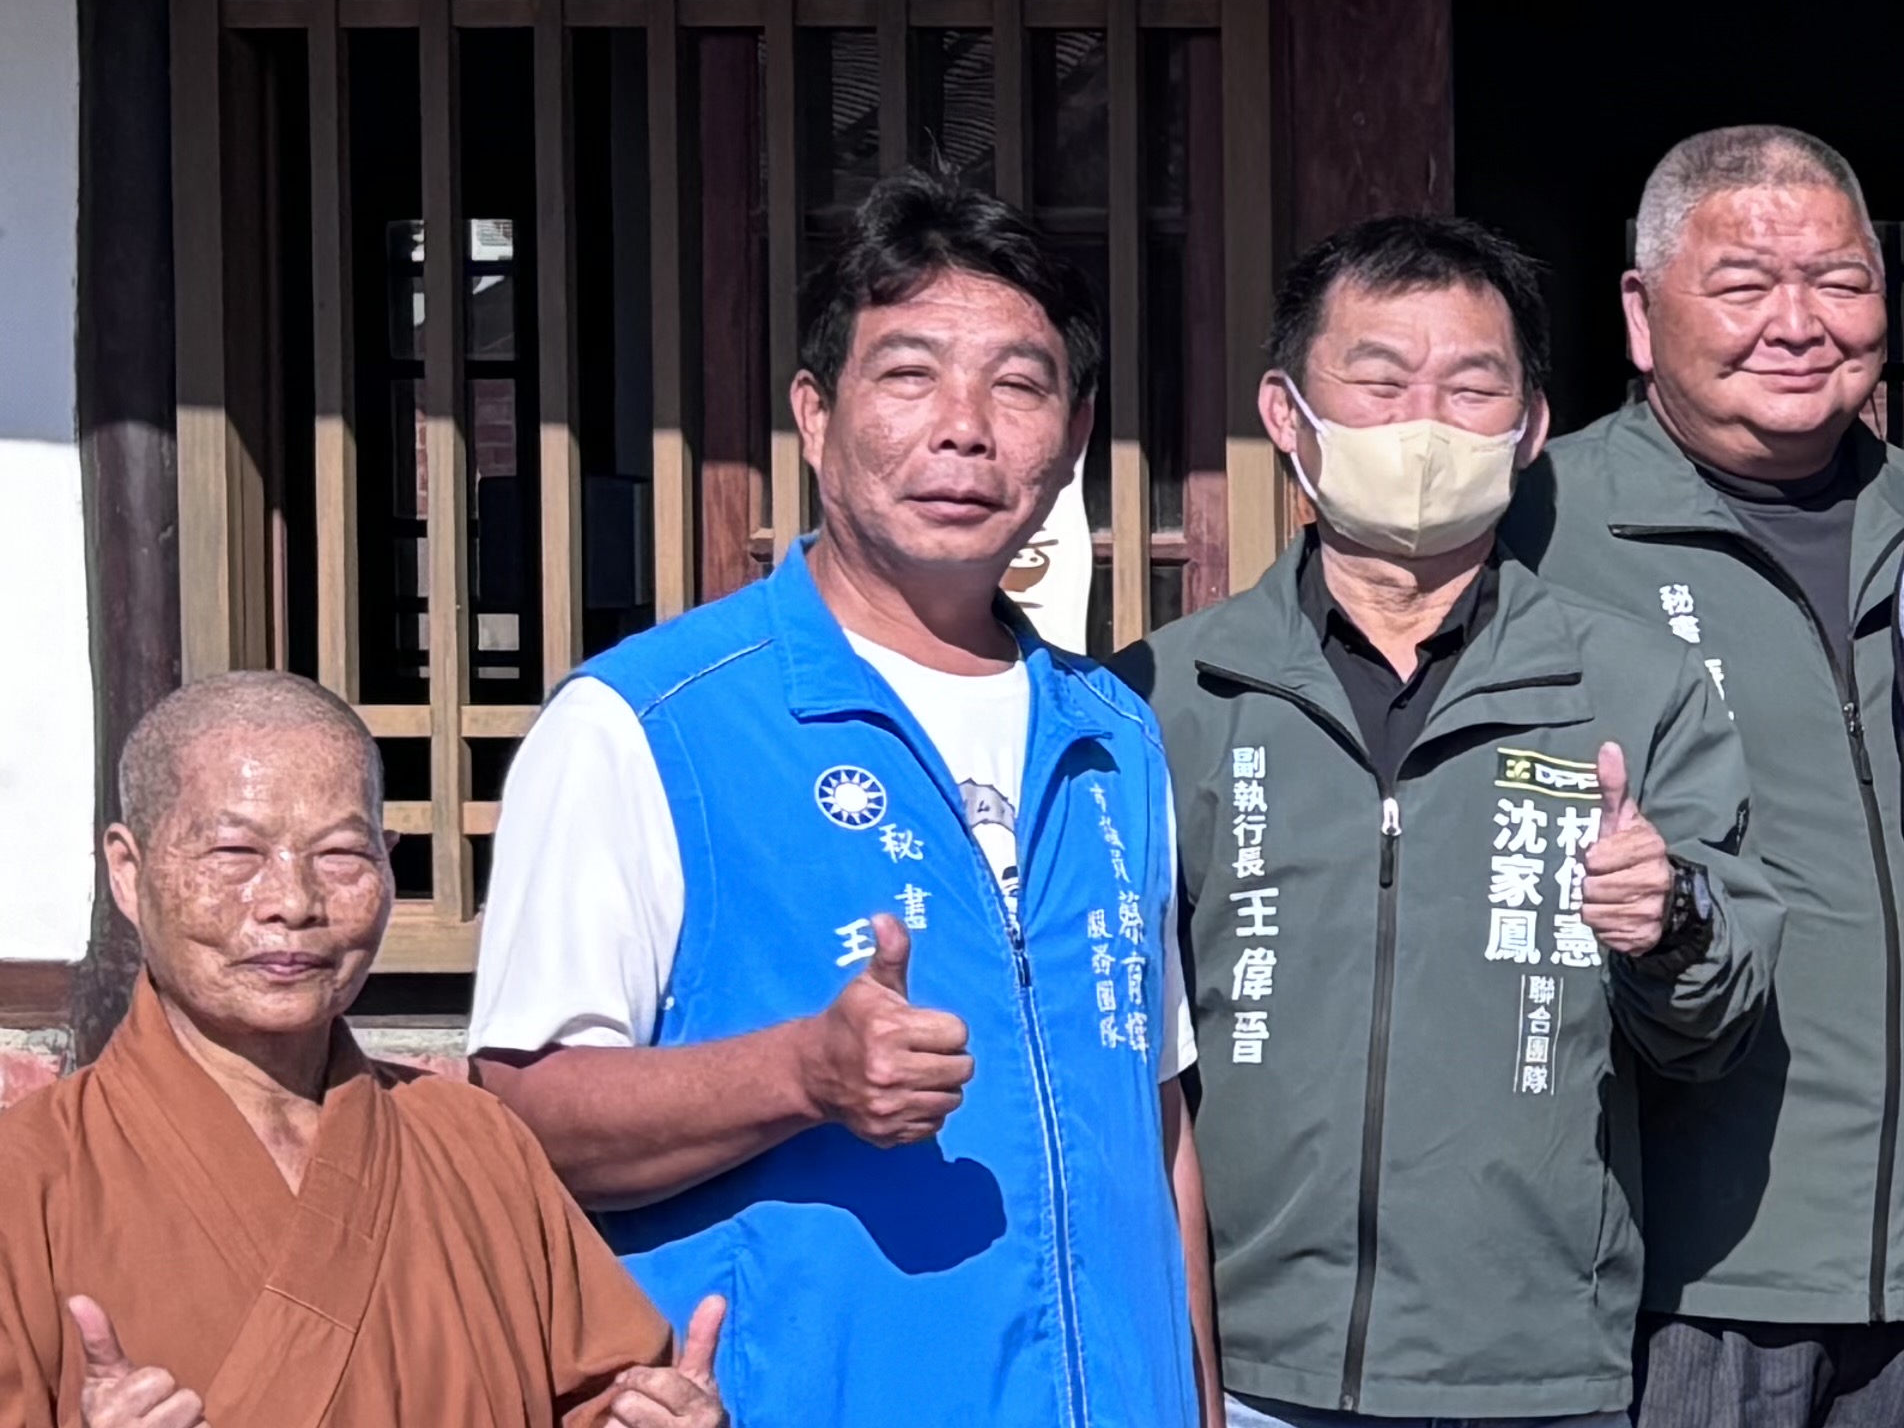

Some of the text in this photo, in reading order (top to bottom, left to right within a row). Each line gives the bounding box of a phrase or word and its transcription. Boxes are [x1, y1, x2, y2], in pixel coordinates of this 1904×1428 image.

[1230, 746, 1267, 878] 副執行長
[877, 822, 933, 930] 秘書
[1484, 798, 1548, 965] 沈家鳳
[1521, 975, 1556, 1095] 聯合團隊
